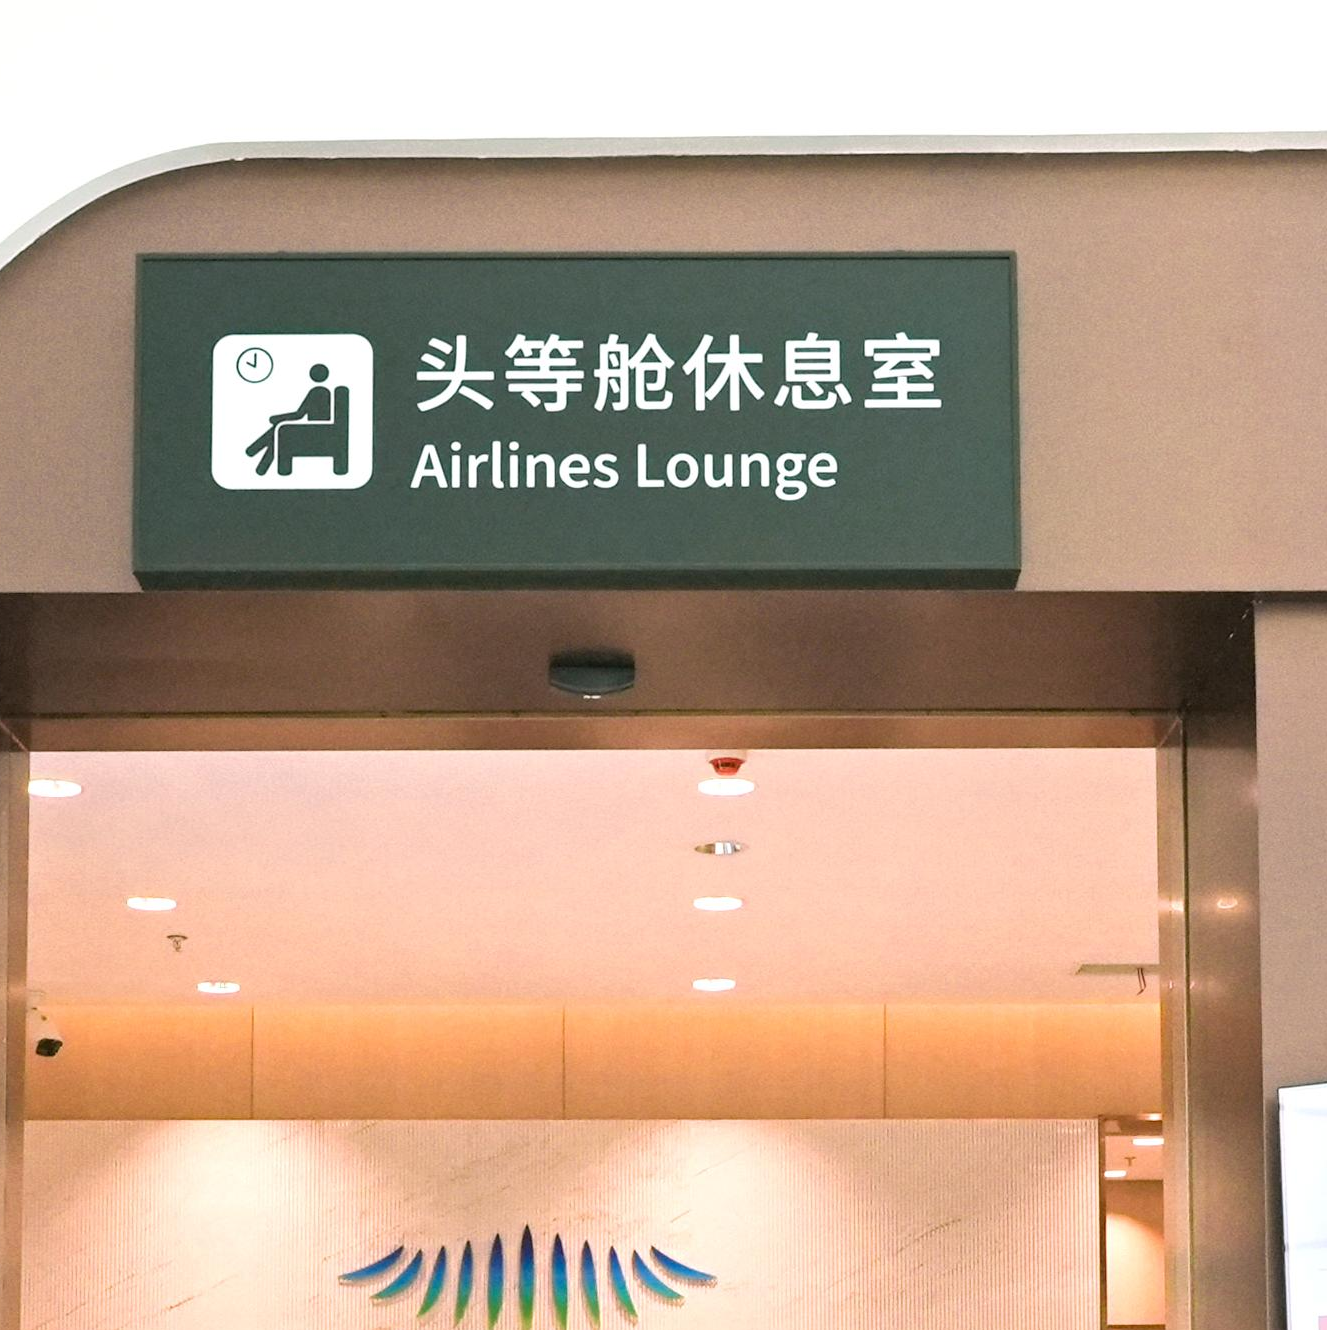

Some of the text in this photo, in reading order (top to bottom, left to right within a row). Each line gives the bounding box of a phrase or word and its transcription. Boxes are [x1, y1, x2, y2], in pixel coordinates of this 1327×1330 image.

[414, 331, 944, 413] 头等舱休息室
[410, 439, 839, 501] Airlines Lounge
